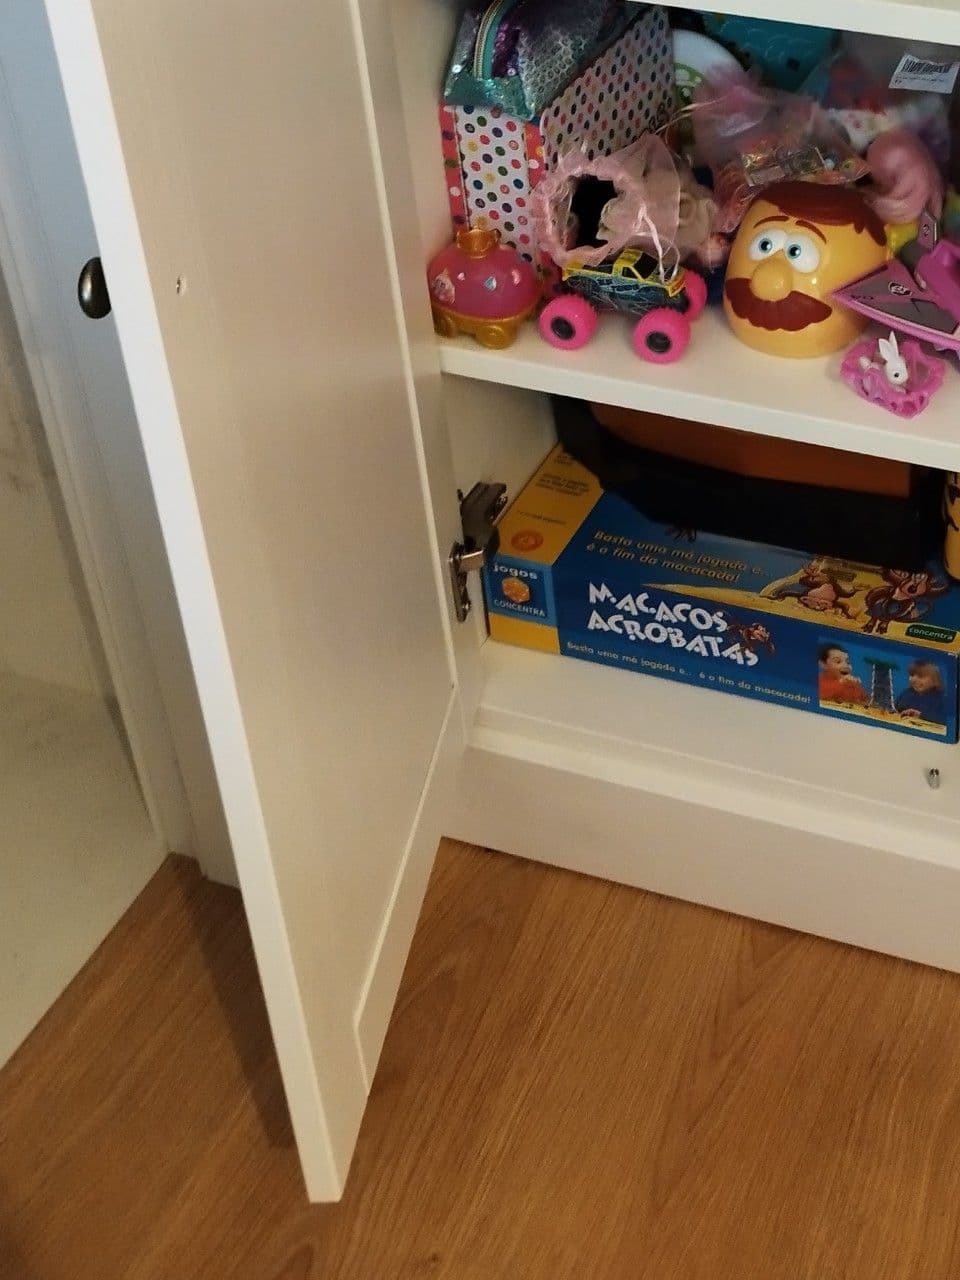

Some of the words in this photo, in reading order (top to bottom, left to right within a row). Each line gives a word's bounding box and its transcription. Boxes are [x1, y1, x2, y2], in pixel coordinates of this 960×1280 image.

[593, 531, 633, 548] Basta
[637, 541, 666, 555] uma
[697, 553, 748, 571] jogada
[613, 545, 636, 560] fim
[662, 557, 740, 582] macacada!
[494, 564, 538, 580] jogos
[494, 598, 545, 617] CONCENTRA
[589, 580, 728, 632] MACACOS
[587, 610, 760, 666] ACROBATAS
[908, 626, 954, 641] concentra
[567, 640, 593, 656] Basta
[597, 649, 619, 660] uma
[640, 656, 676, 674] jogada
[718, 675, 735, 686] fim
[738, 679, 752, 690] da
[754, 684, 811, 704] macacada!
